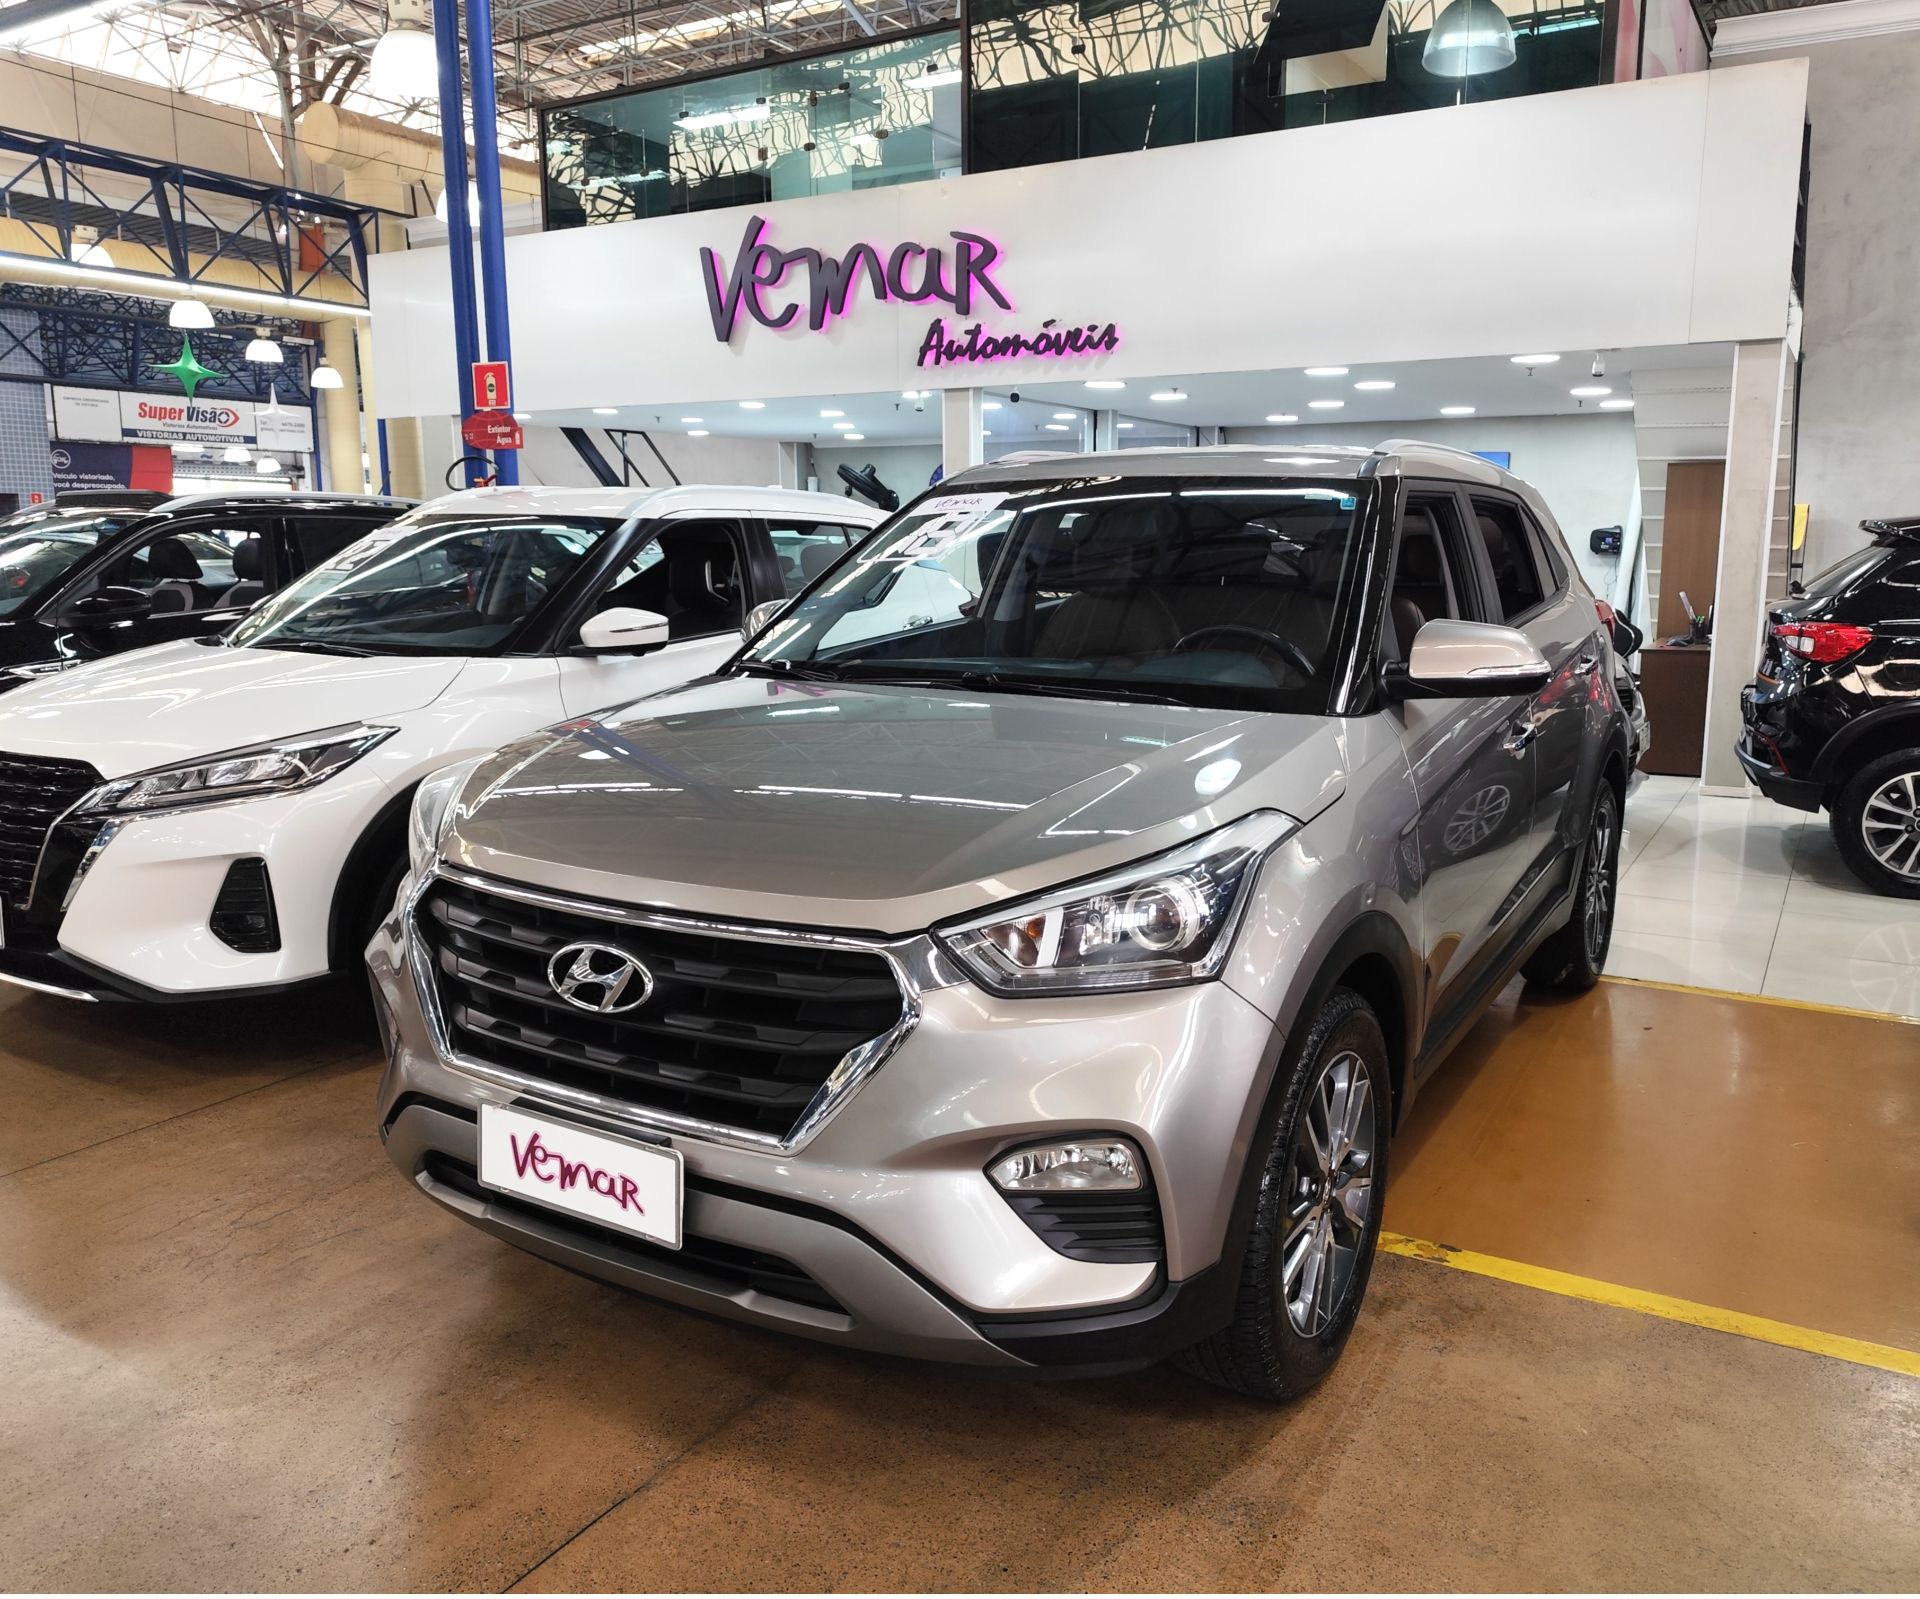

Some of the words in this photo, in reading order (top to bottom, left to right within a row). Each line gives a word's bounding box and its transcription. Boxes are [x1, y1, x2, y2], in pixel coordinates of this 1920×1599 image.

[917, 318, 1119, 368] Automóveis
[138, 401, 184, 422] Super
[186, 406, 231, 426] Visão
[137, 429, 184, 440] VISTORIAS
[186, 432, 245, 444] AUTOMOTIVAS
[487, 424, 511, 434] Extintor
[54, 481, 70, 489] você
